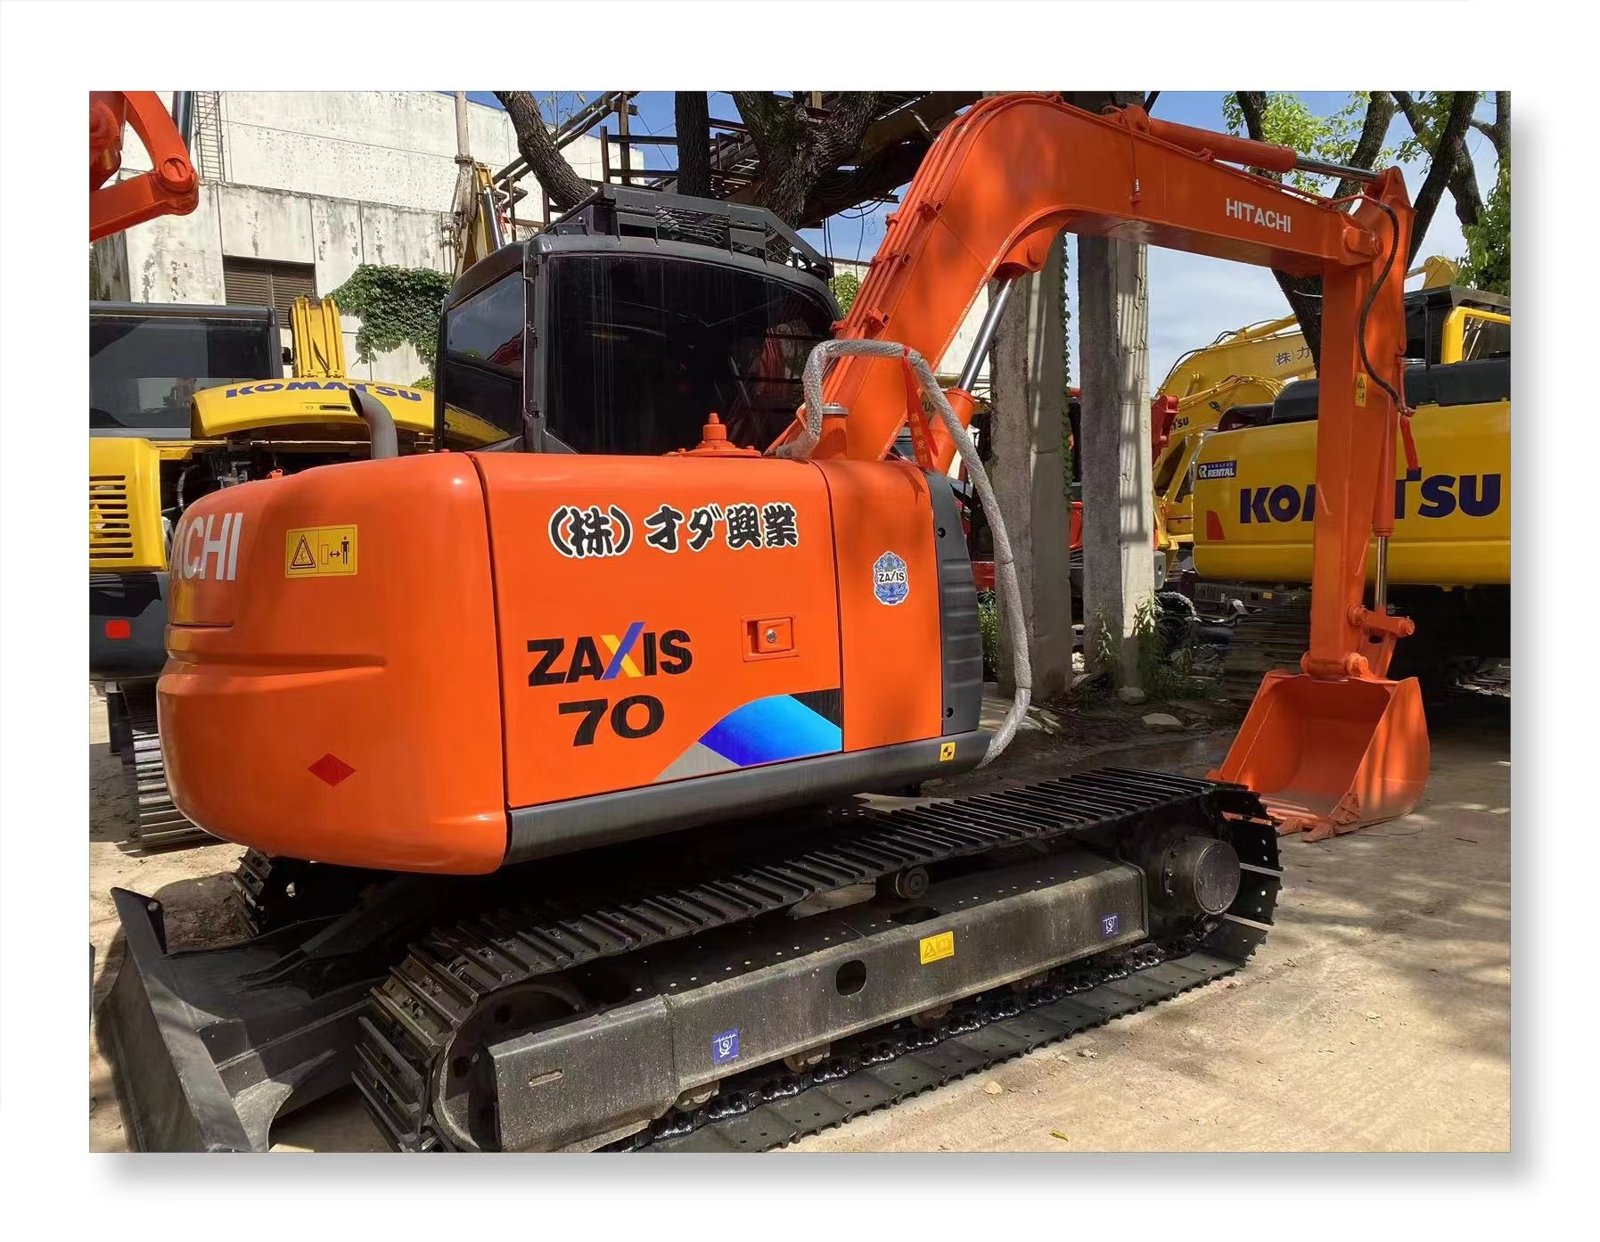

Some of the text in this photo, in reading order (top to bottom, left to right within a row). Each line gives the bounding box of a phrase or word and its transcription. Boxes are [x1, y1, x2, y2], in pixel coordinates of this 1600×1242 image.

[1226, 198, 1291, 233] HITACHI
[225, 381, 421, 401] KOMATSU
[1207, 467, 1235, 478] RENTAL
[879, 571, 905, 583] ZAXIS
[527, 621, 694, 687] ZAXIS
[558, 694, 665, 748] 70
